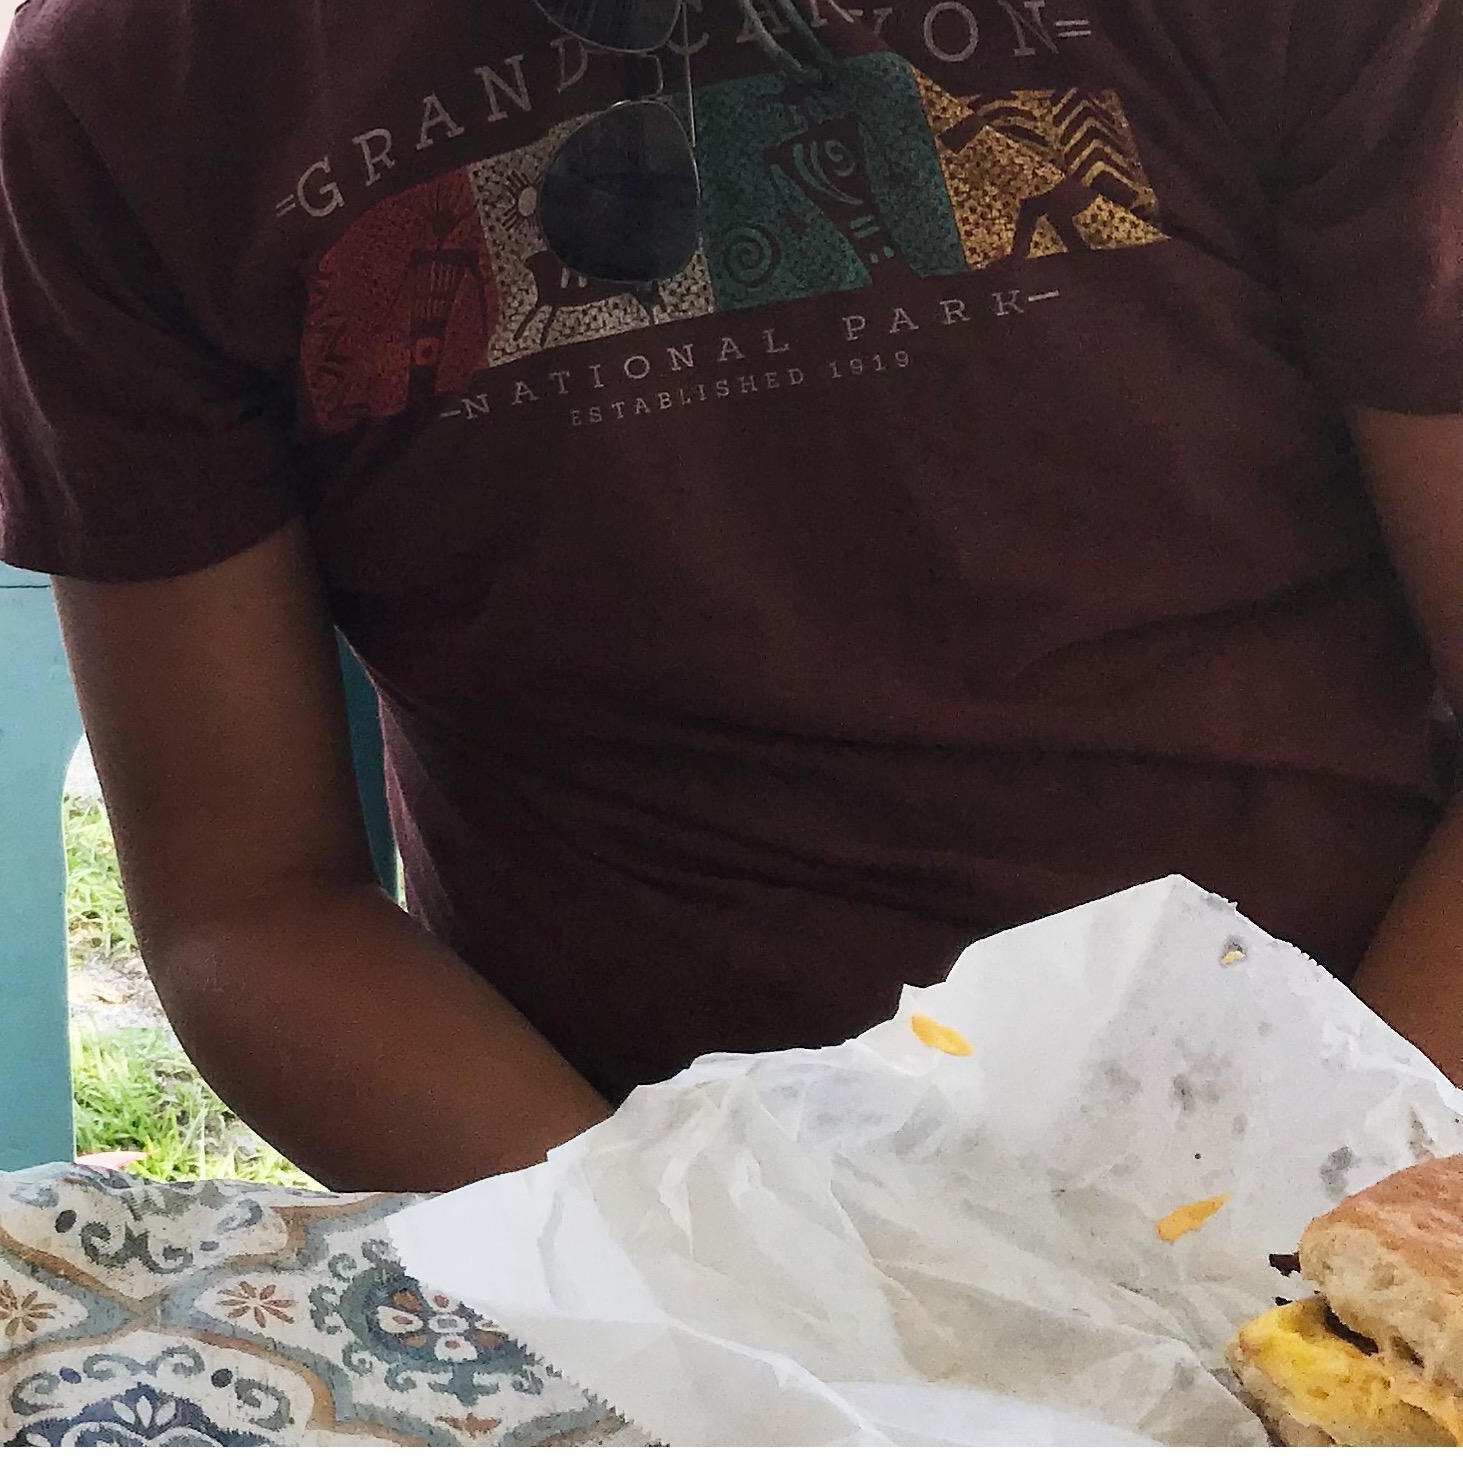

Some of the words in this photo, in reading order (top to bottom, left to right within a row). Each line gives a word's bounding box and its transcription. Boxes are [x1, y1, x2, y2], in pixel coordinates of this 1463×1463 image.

[294, 35, 590, 219] GRAND
[461, 327, 791, 421] NATIONAL
[841, 288, 1025, 342] PARK
[570, 366, 805, 427] ESTABLISHED
[828, 349, 911, 380] 1919
